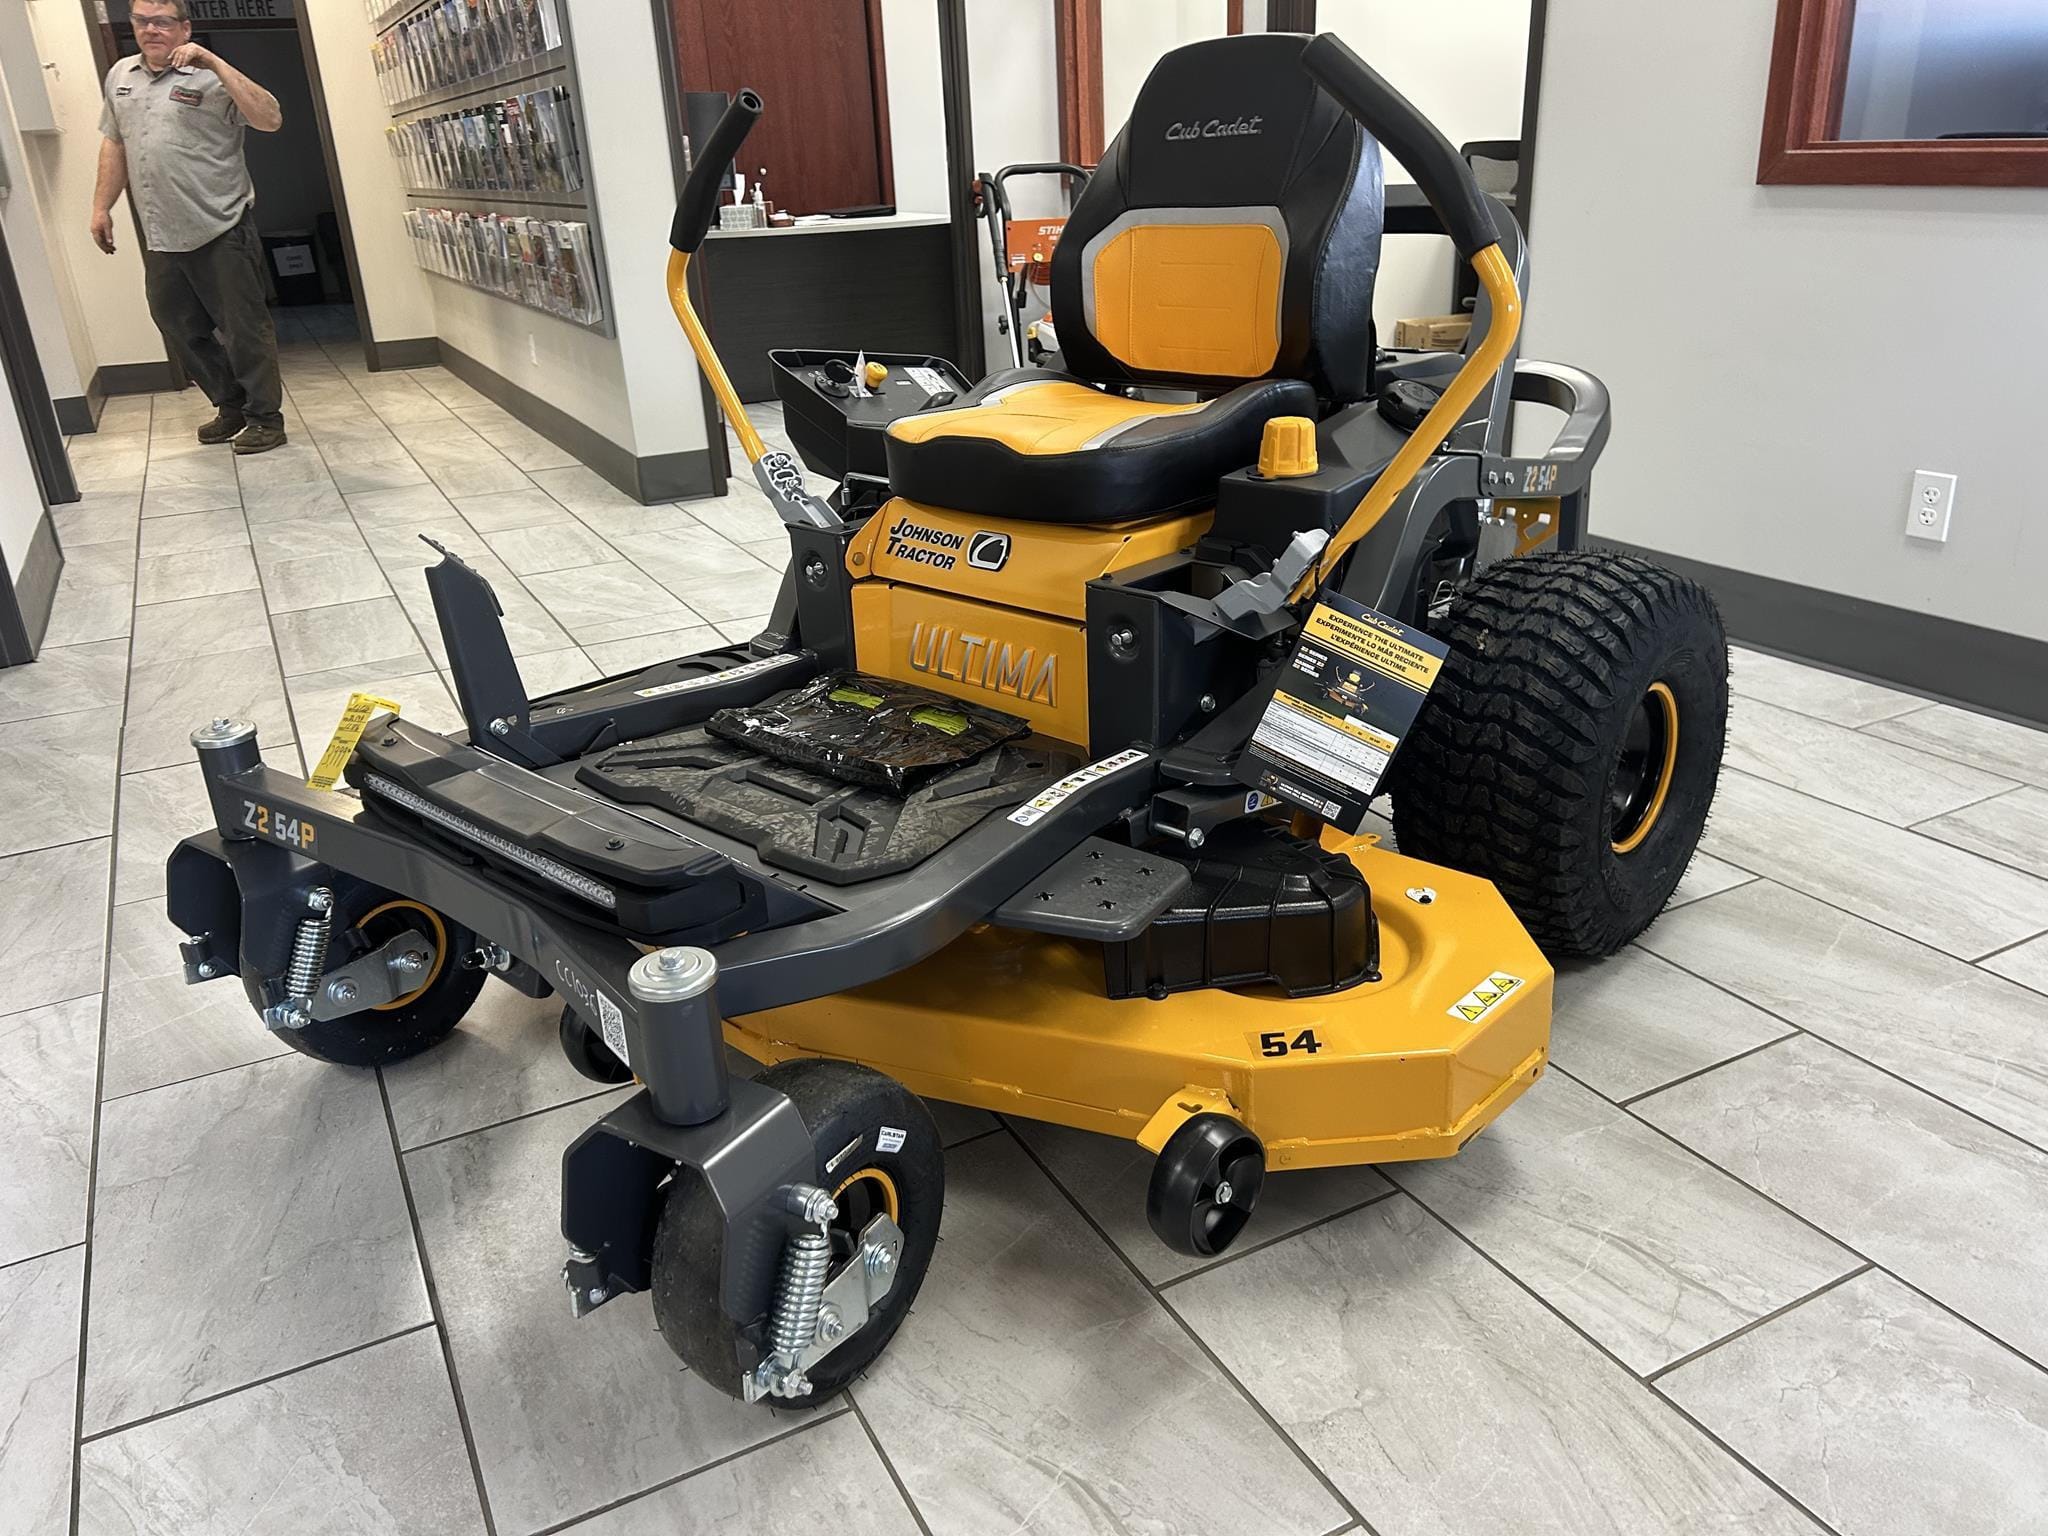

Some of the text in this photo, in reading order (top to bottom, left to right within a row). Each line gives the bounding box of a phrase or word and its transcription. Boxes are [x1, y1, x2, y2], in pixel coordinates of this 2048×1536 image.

[185, 0, 276, 18] NTER HERE
[1165, 115, 1263, 140] Cub Cadet
[1038, 225, 1065, 236] STIH
[1523, 464, 1558, 493] Z2 54P
[889, 517, 965, 550] JOHNSON
[885, 536, 956, 570] TRACTOR
[1315, 617, 1366, 645] EXPERIMENTE
[1366, 640, 1377, 650] LO
[1394, 653, 1430, 674] RECIENTE
[1328, 613, 1424, 662] EXPERIENCE THE ULTIMATE
[909, 622, 1059, 709] ULTIMA
[1380, 655, 1407, 673] ULTIME
[244, 800, 315, 849] Z2 54P
[1260, 1029, 1322, 1057] 54
